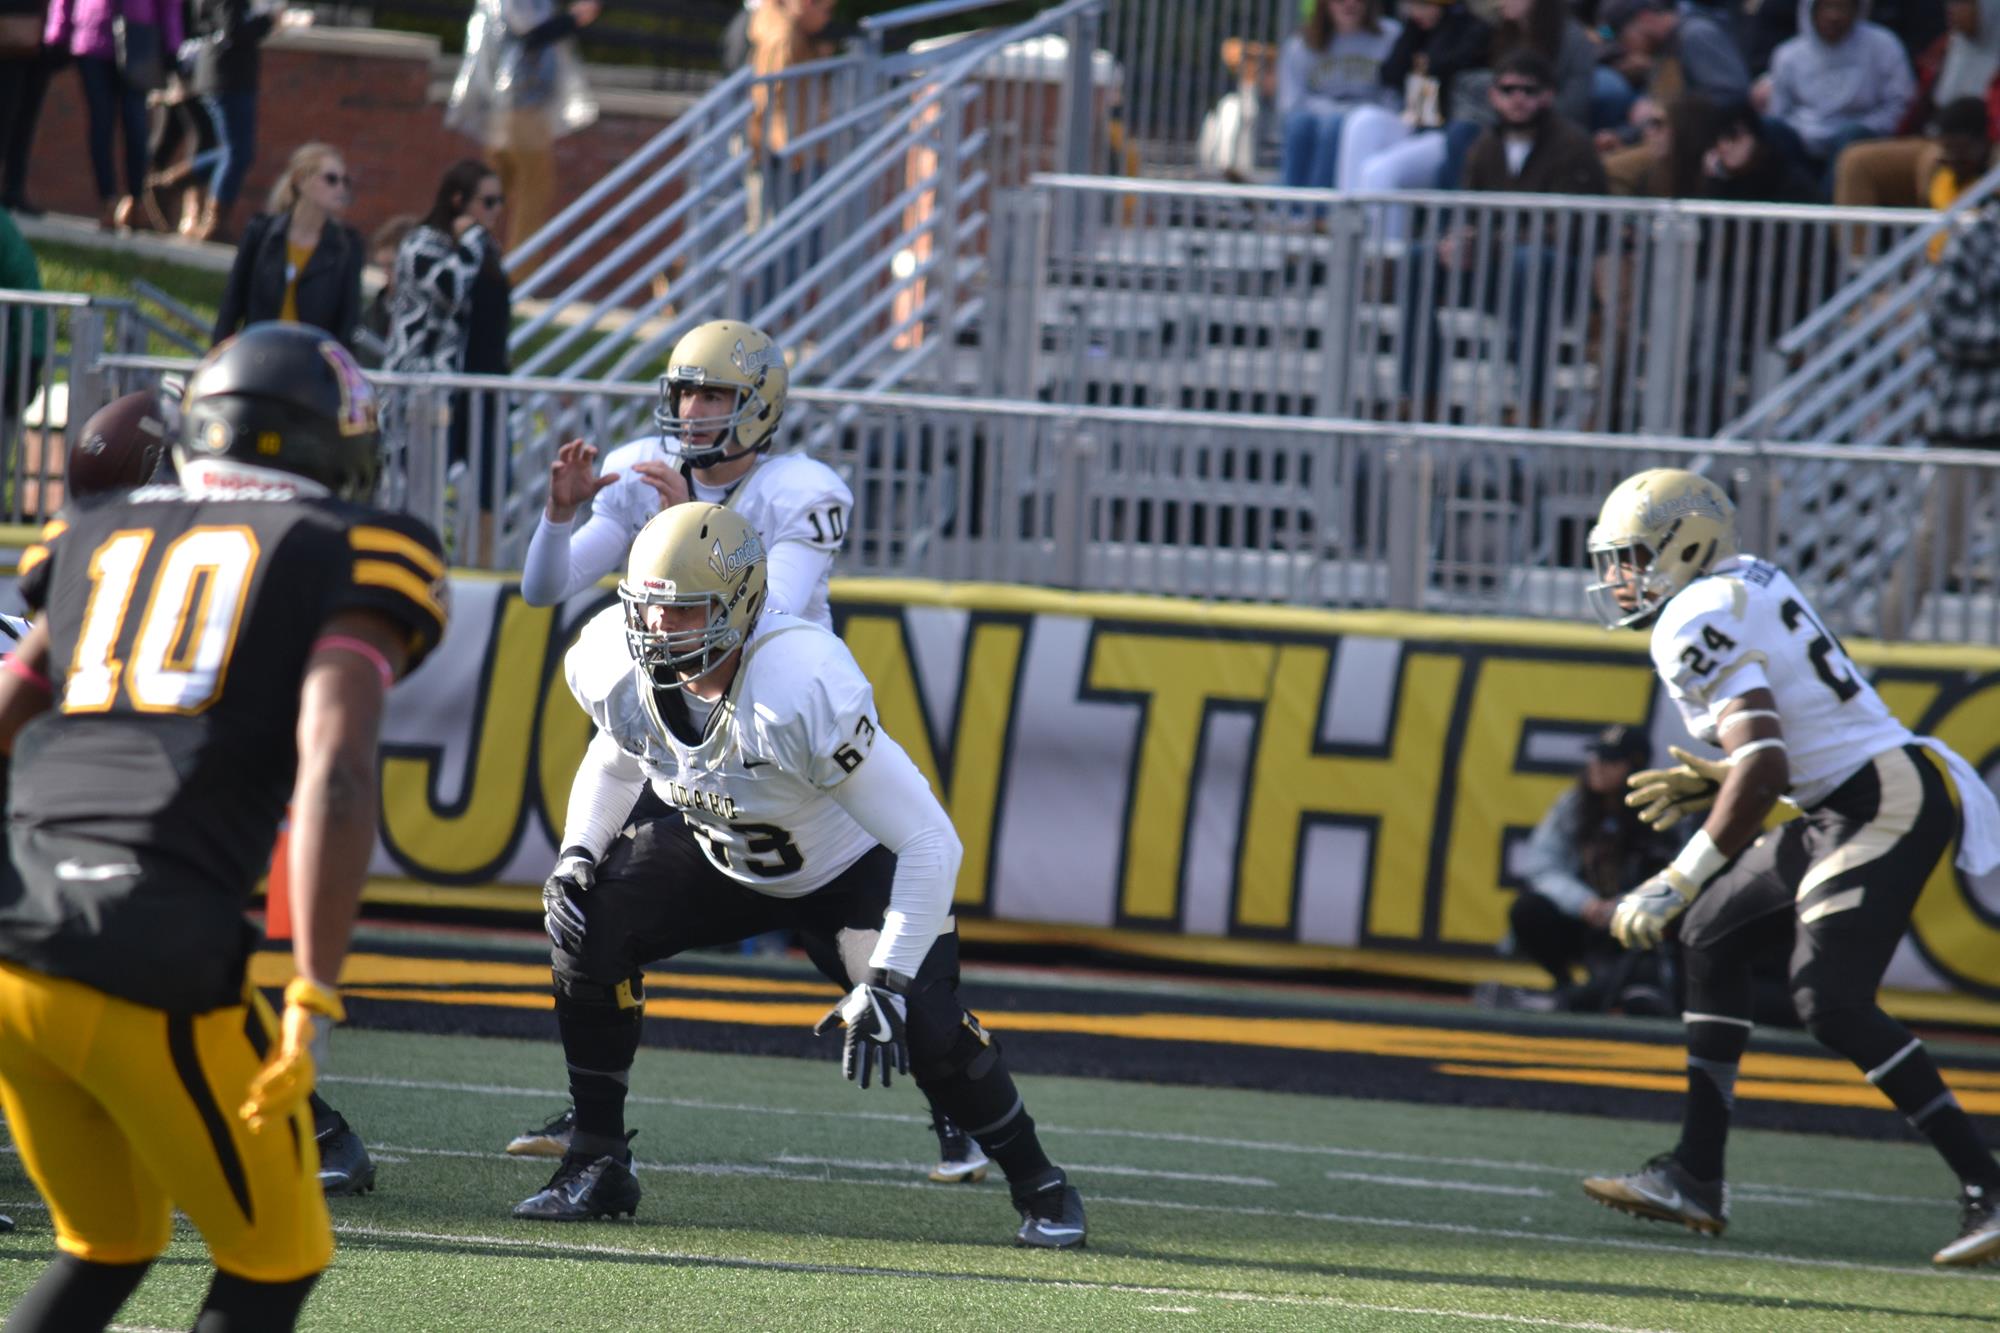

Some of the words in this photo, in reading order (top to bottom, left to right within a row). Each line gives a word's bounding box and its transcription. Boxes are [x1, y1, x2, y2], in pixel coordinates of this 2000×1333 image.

[808, 505, 843, 544] 10
[59, 524, 260, 716] 10
[1680, 623, 1737, 677] 24
[1780, 597, 1864, 702] 2
[832, 714, 876, 774] 63
[1080, 621, 1657, 952] THE
